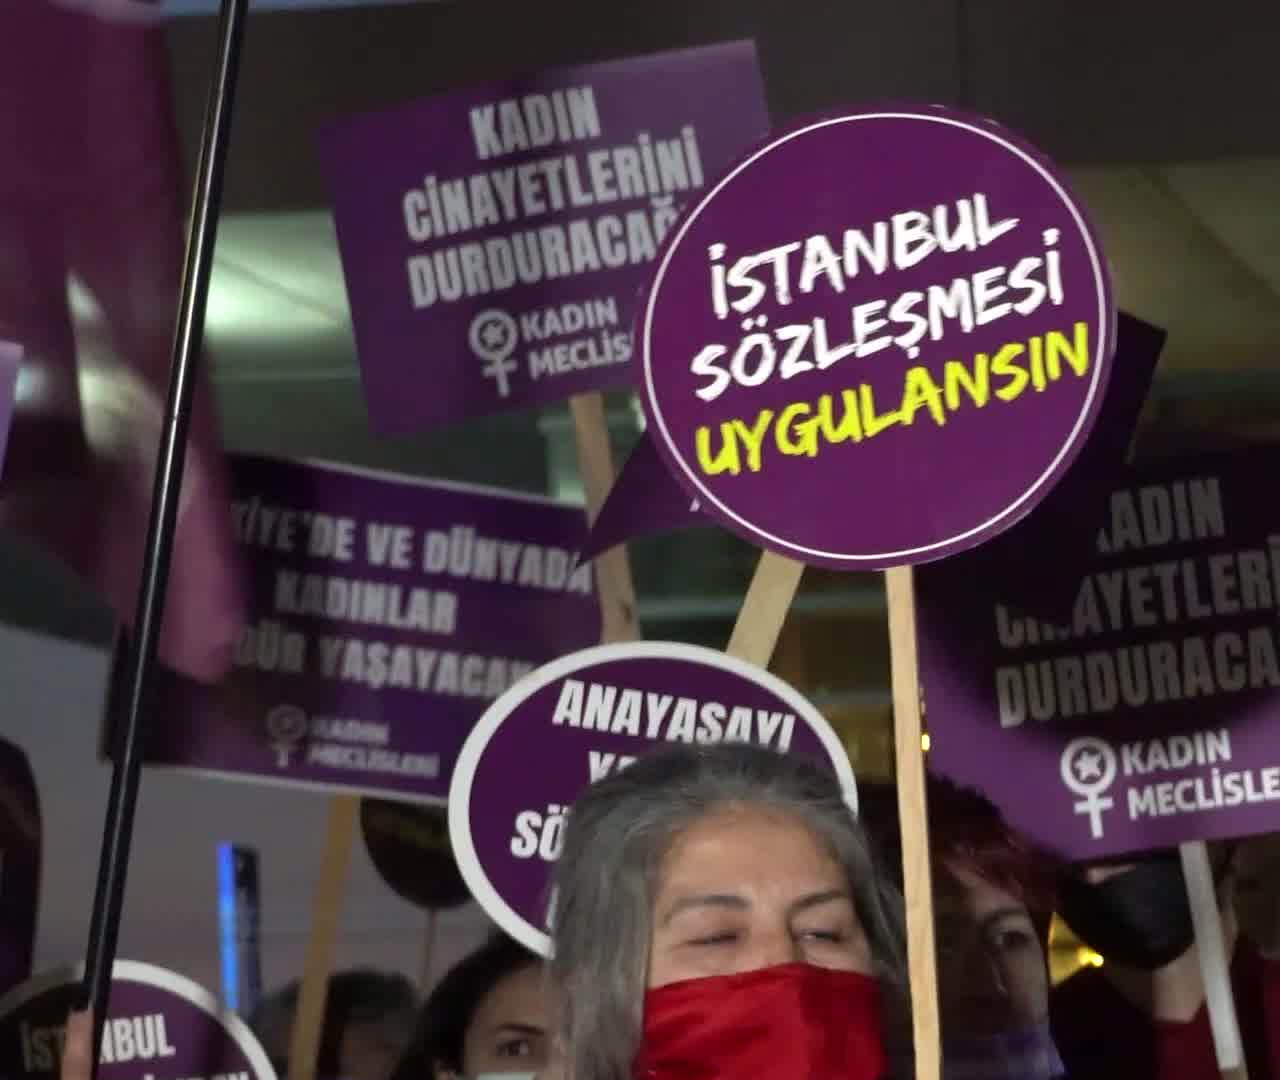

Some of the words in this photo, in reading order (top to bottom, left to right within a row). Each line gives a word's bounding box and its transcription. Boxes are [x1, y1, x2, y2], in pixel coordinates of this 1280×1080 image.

[469, 85, 600, 160] KADIN
[403, 125, 704, 242] CİNAYETLERİNİ
[406, 196, 684, 310] DURDURACAĞ
[707, 193, 1020, 320] İSTANBUL
[519, 297, 620, 342] KADIN
[690, 227, 1064, 402] SÖZLEŞMESİ
[527, 330, 636, 381] MECLİS
[695, 322, 1090, 476] UYGULANSIN
[1097, 478, 1226, 554] ADIN
[366, 521, 414, 568] VE
[423, 524, 594, 593] DÜNYADA
[274, 570, 459, 636] KADINLAR
[552, 679, 796, 754] ANAYASAYI
[1120, 729, 1232, 776] KADIN
